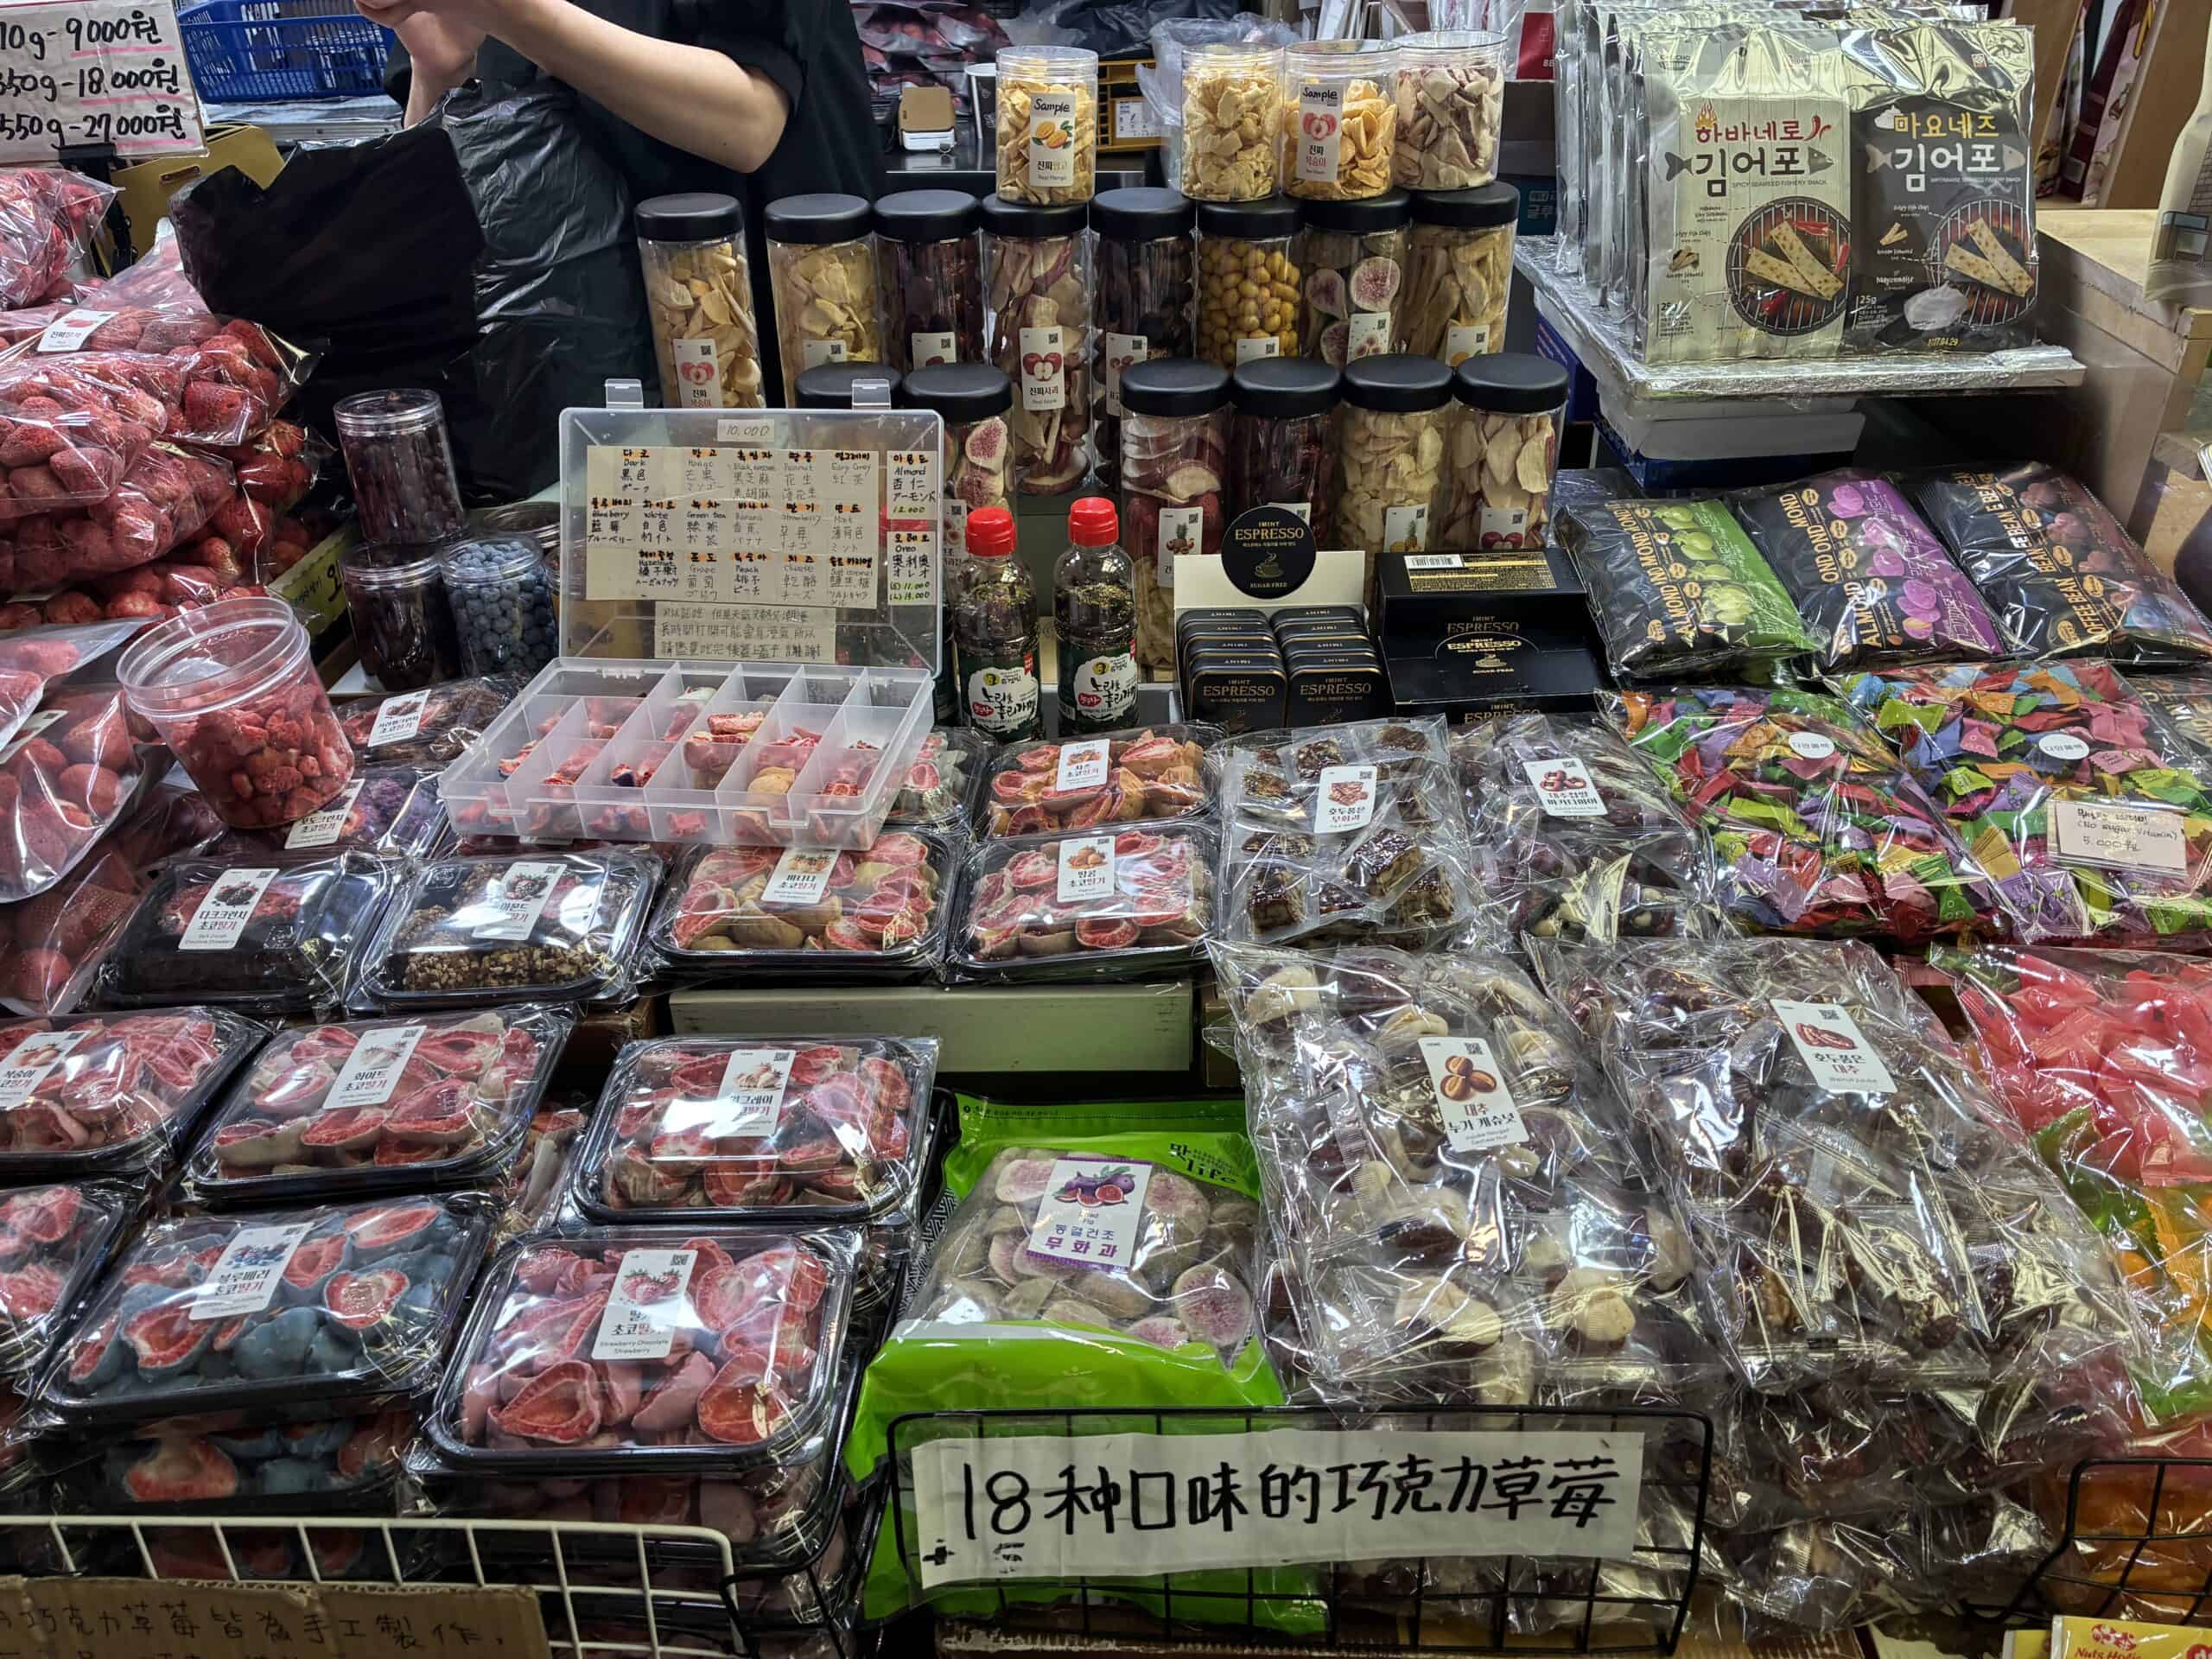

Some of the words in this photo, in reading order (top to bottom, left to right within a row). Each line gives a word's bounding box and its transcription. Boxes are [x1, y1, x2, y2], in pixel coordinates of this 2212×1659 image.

[1303, 86, 1338, 102] Sample
[1033, 99, 1071, 115] Sample
[1894, 111, 1999, 139] 마요네즈
[1695, 121, 1804, 143] 하바네로
[1695, 146, 1805, 197] 김어포
[1894, 143, 2000, 192] 김어포
[692, 389, 707, 398] 진짜
[623, 459, 646, 467] Dark
[893, 467, 927, 476] Almond
[1235, 527, 1305, 540] ESPRESSO
[1843, 582, 1884, 648] ALMOND
[1446, 622, 1520, 633] ESPRESSO
[1447, 639, 1522, 650] ESPRESSO
[1203, 685, 1276, 696] ESPRESSO
[1300, 683, 1372, 696] ESPRESSO
[1068, 768, 1099, 778] 초코딸기
[779, 881, 817, 890] 초코딸기
[1071, 878, 1106, 888] 초코딸기
[198, 920, 238, 931] 초코딸기
[354, 1070, 390, 1081] 화이트
[1832, 1064, 1860, 1074] 대추
[342, 1079, 388, 1092] 초코딸기
[1465, 1103, 1489, 1116] 대추
[1448, 1120, 1474, 1134] 누가
[1055, 1224, 1116, 1241] 동결건조
[1045, 1236, 1119, 1258] 무화과
